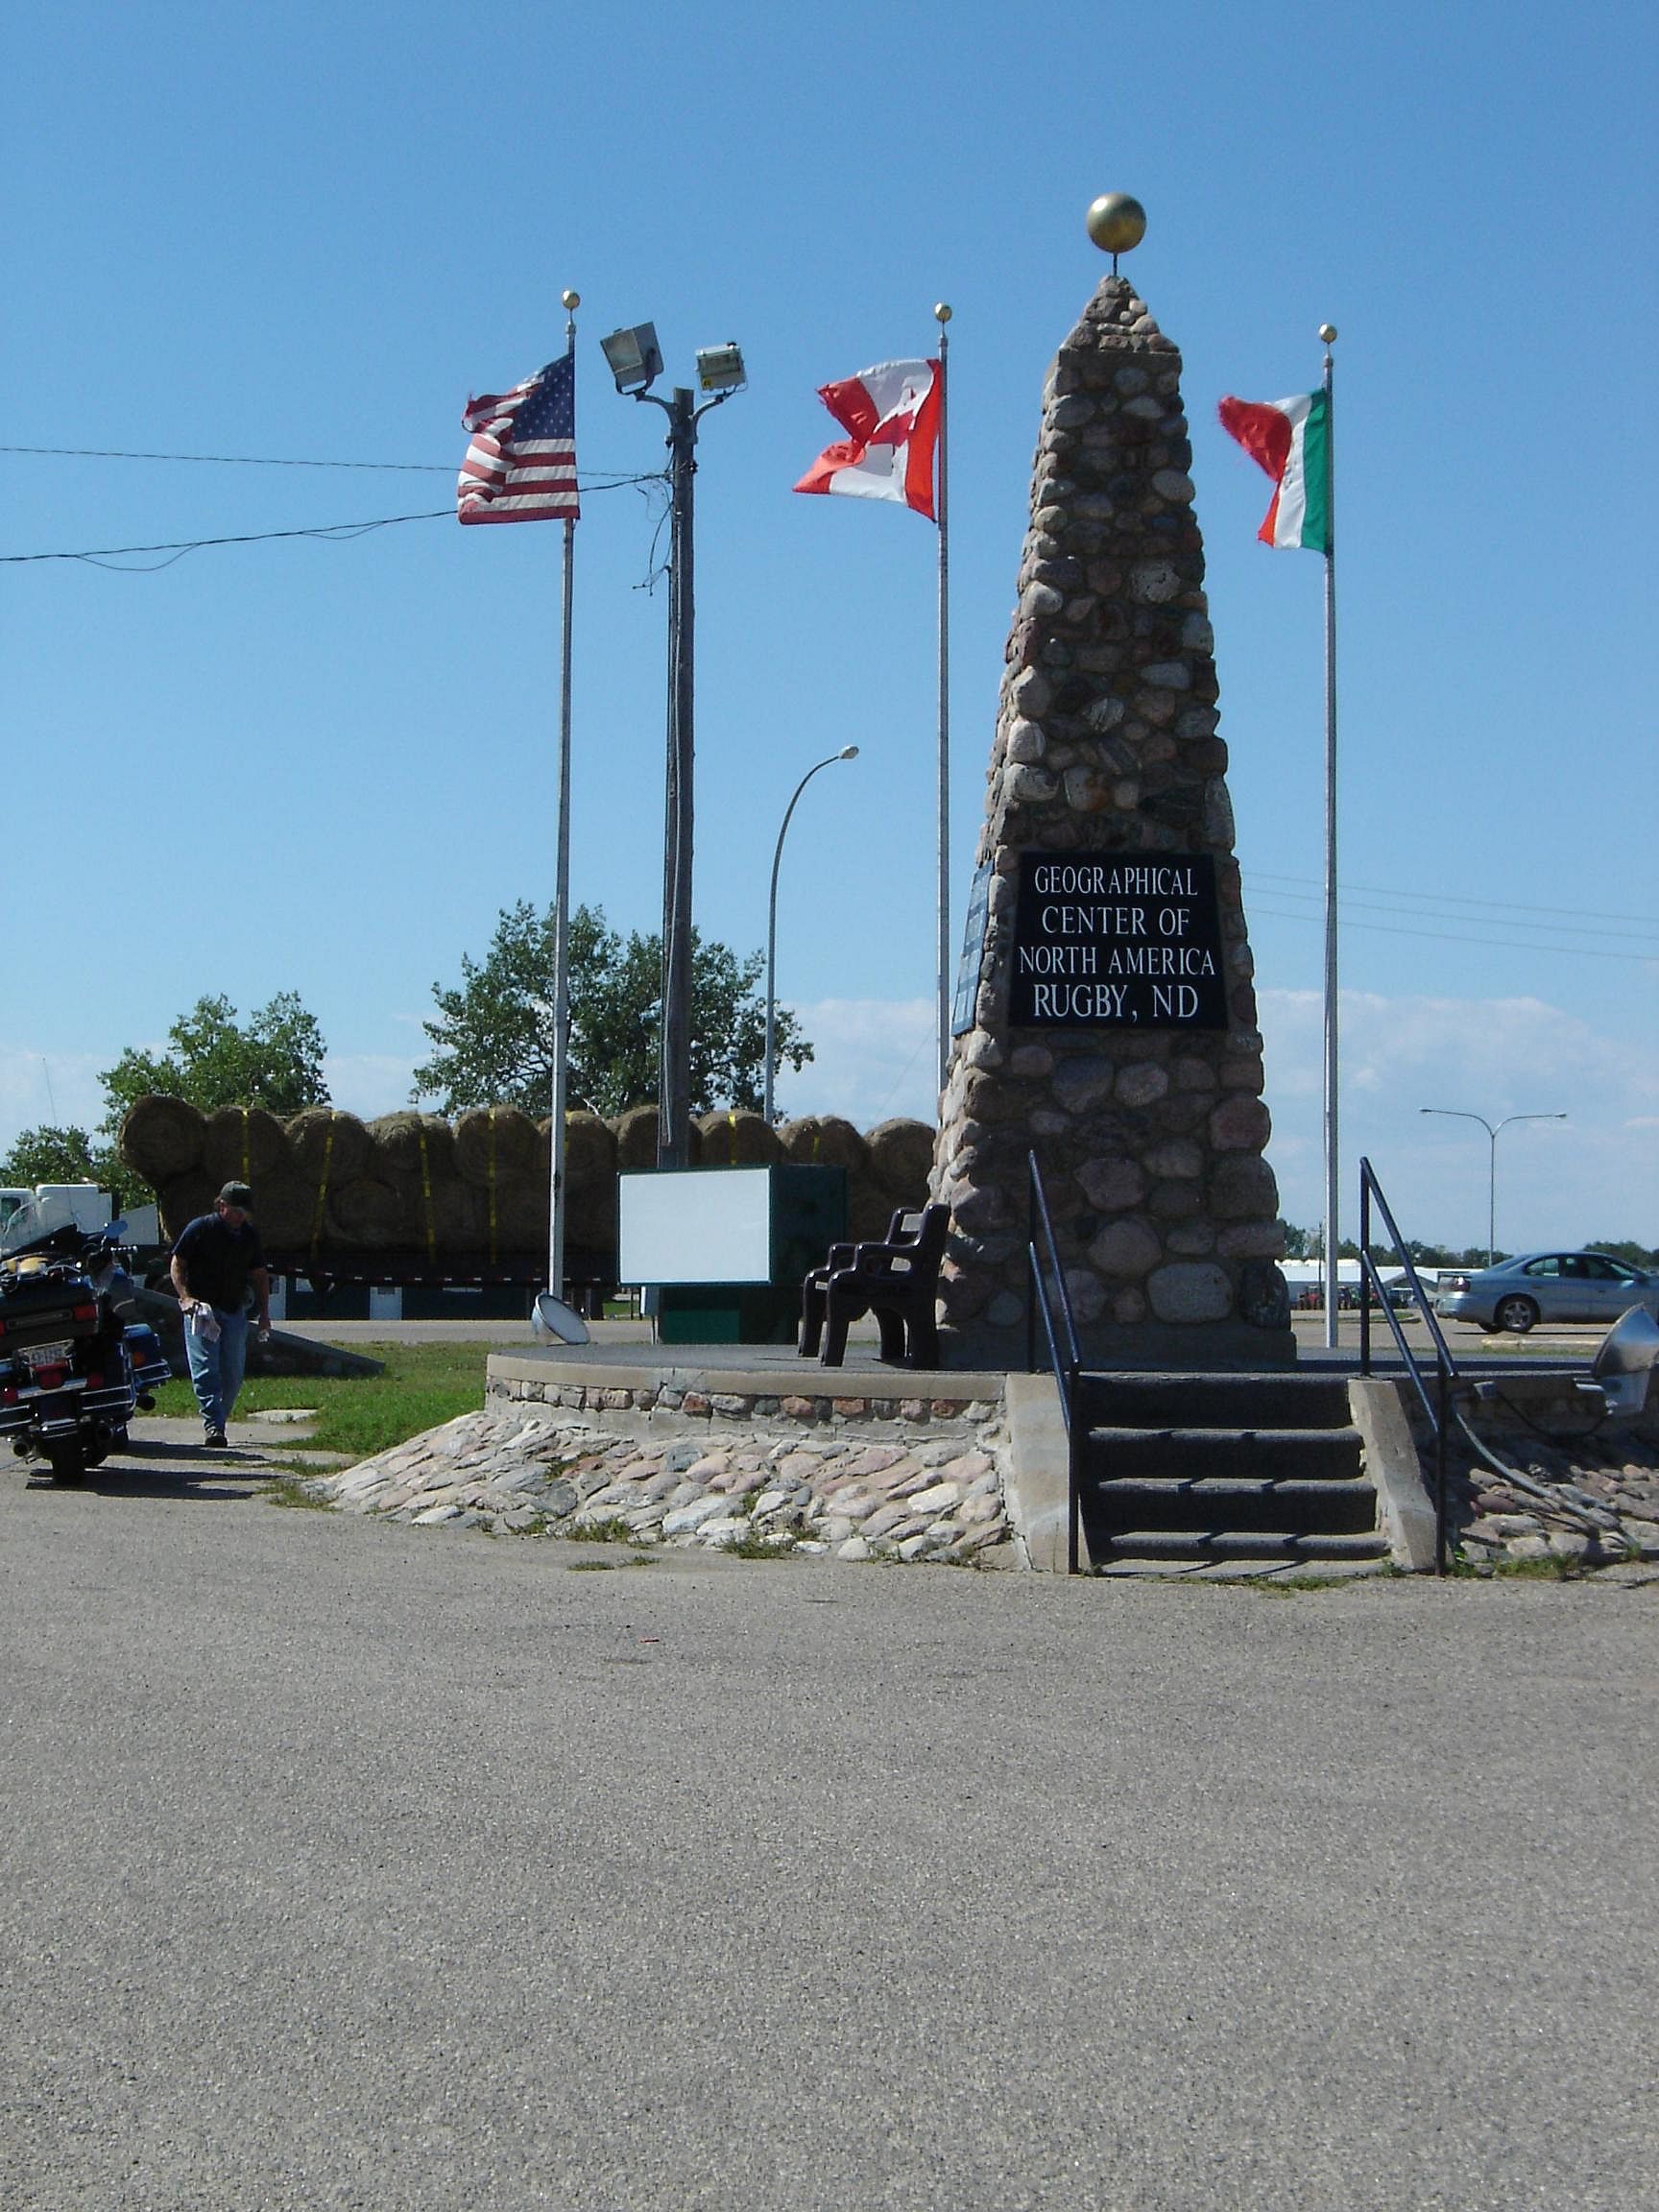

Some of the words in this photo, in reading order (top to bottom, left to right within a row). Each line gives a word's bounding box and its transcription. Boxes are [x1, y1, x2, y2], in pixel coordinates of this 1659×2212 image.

[1035, 866, 1197, 896] GEOGRAPHICAL
[1042, 905, 1146, 935] CENTER
[1159, 907, 1190, 936] OF
[1019, 946, 1096, 974] NORTH
[1108, 948, 1215, 975] AMERICA
[1034, 984, 1139, 1022] RUGBY,
[1153, 985, 1198, 1018] ND
